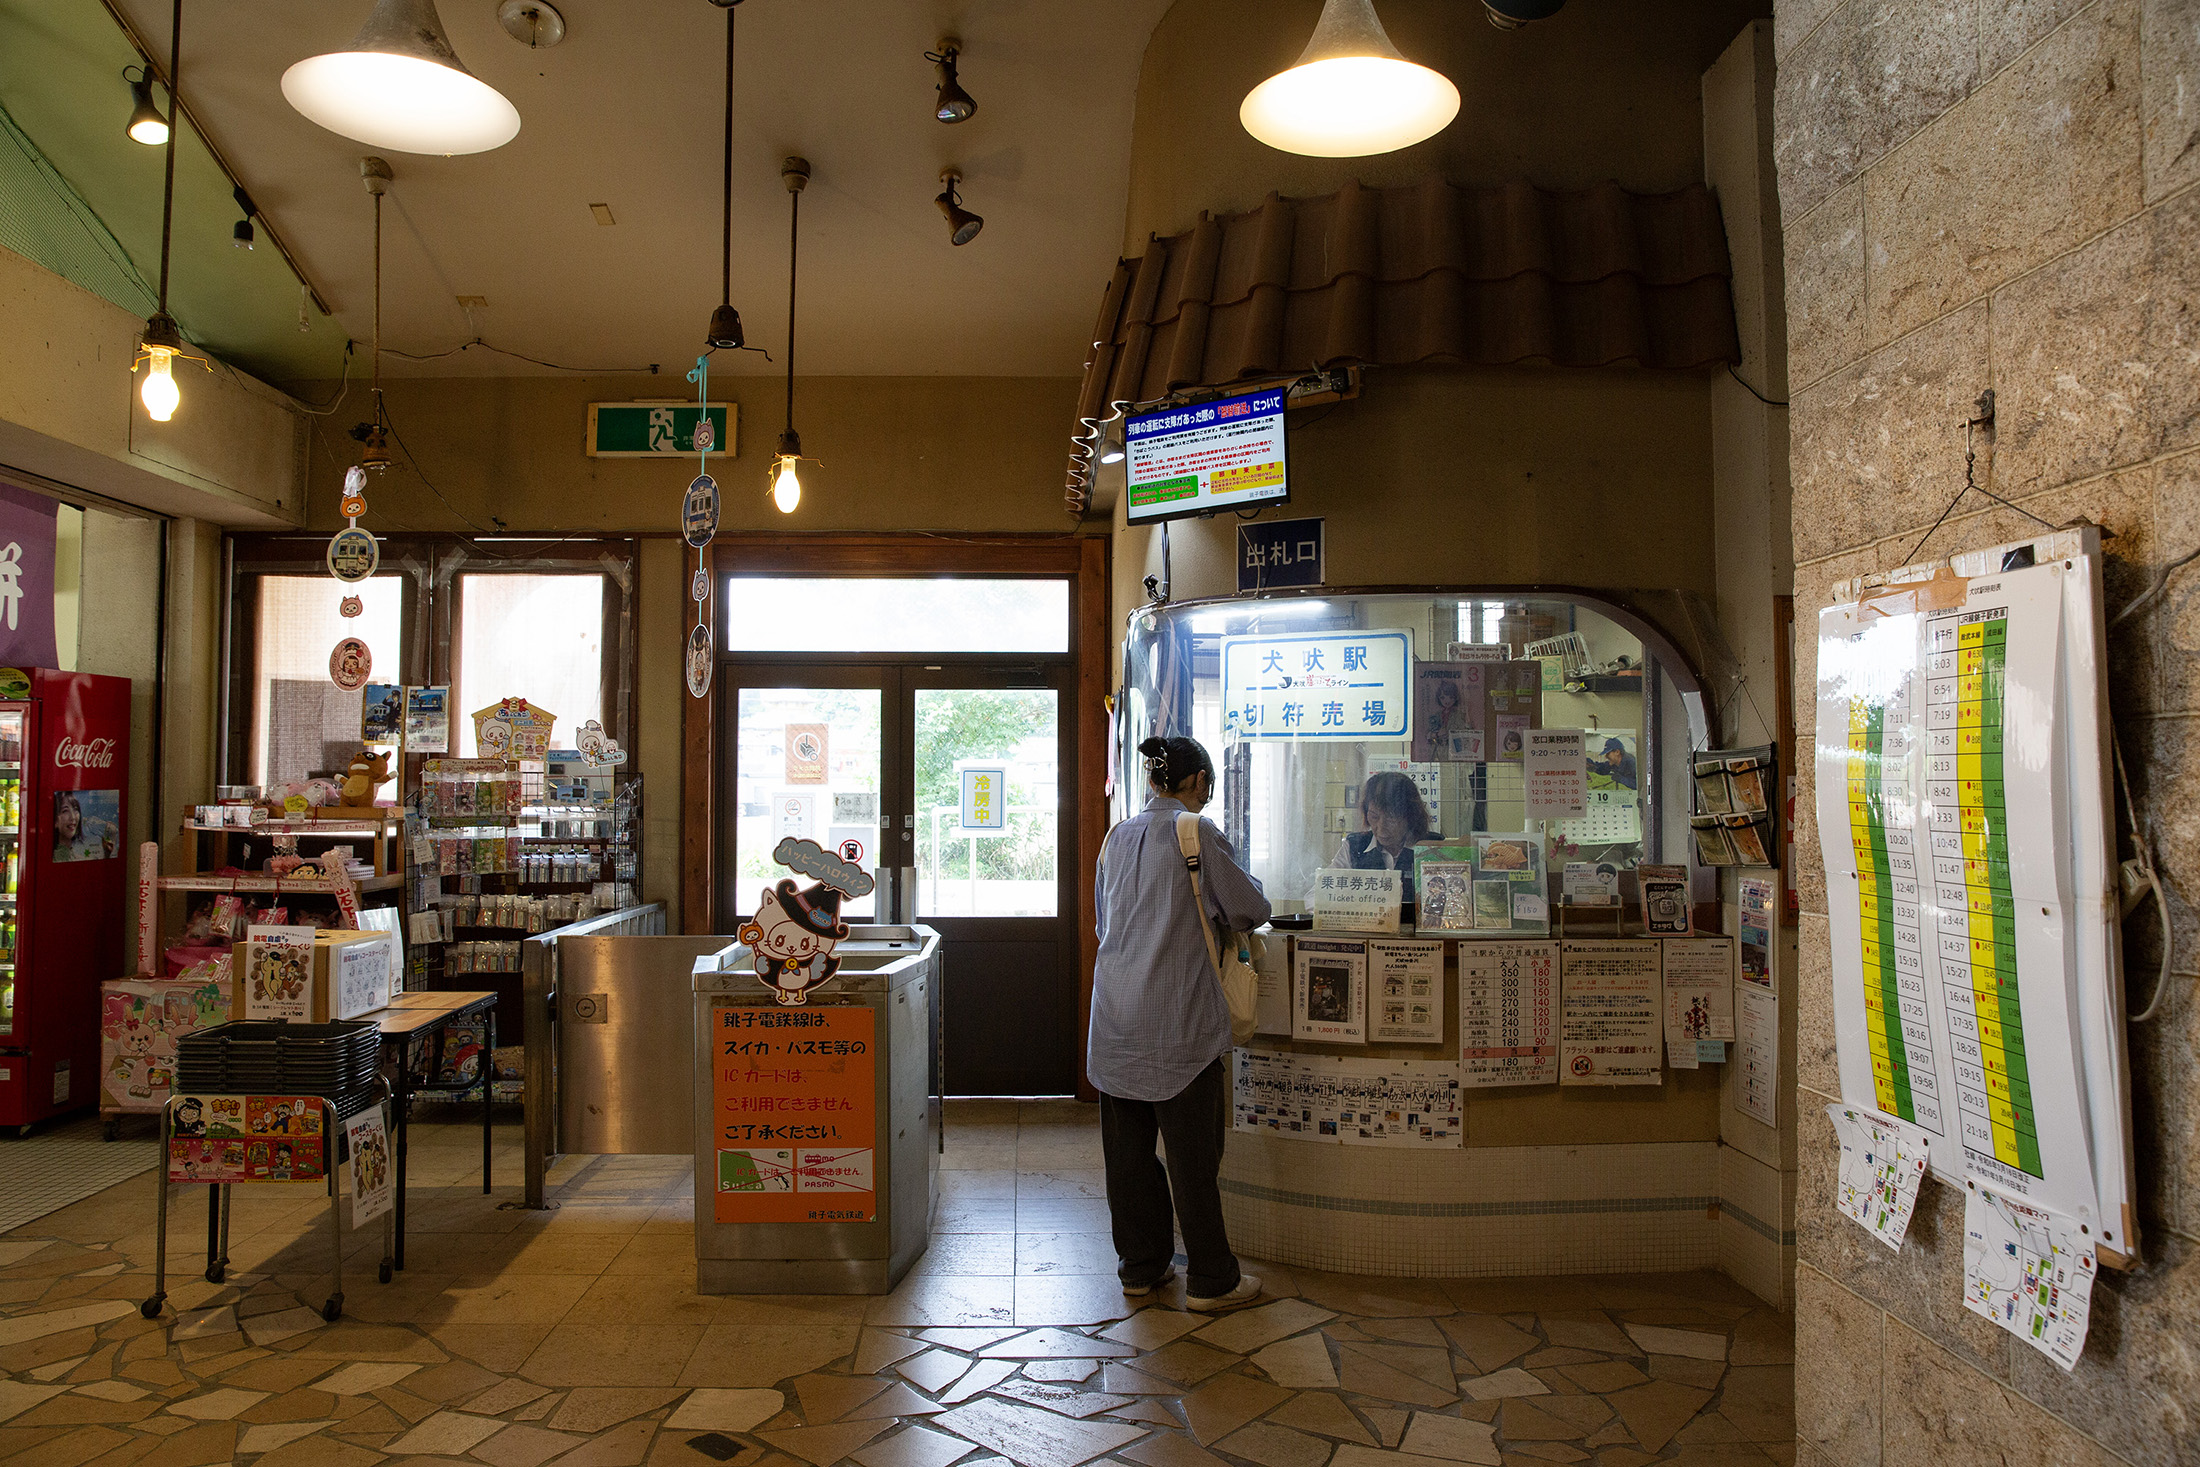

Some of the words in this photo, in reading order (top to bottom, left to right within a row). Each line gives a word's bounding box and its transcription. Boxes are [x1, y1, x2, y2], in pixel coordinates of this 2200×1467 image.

[1246, 540, 1316, 568] 出札口
[1969, 583, 2001, 596] 犬吠駅時刻表
[1262, 646, 1368, 674] 犬吠駅
[1934, 684, 1950, 695] 6:54
[1244, 700, 1386, 727] 切符売場
[1889, 714, 1903, 723] 7:11
[1934, 709, 1950, 720] 7:19
[1532, 736, 1580, 744] 窓口業務時間
[1888, 737, 1902, 747] 7:36
[1934, 735, 1950, 746] 7:45
[1933, 761, 1950, 771] 8:13
[974, 774, 991, 824] 冷房中
[1597, 793, 1608, 801] 10
[1888, 787, 1902, 796] 8:30
[1934, 787, 1950, 797] 8:42
[1973, 796, 1983, 804] 9:43
[1936, 812, 1952, 822] 9:33
[1889, 834, 1908, 845] 10:20
[1936, 838, 1958, 849] 10:42
[782, 845, 867, 890] ハッピーハロウィン
[1893, 858, 1911, 869] 11:35
[1939, 864, 1959, 874] 11:47
[1321, 876, 1393, 892] 乗車券売場
[1328, 894, 1354, 902] Ticket
[1358, 894, 1386, 904] office
[1896, 883, 1914, 894] 12:40
[1942, 890, 1963, 901] 12:48
[1897, 908, 1915, 918] 13:32
[1897, 933, 1916, 944] 14:28
[1944, 941, 1965, 953] 14:37
[1501, 968, 1519, 977] 350
[1533, 968, 1550, 976] 180
[1898, 955, 1918, 967] 15:19
[1946, 966, 1967, 978] 15:27
[1501, 978, 1519, 987] 300
[1533, 978, 1550, 986] 150
[1501, 989, 1519, 997] 300
[1533, 988, 1550, 996] 150
[1901, 979, 1921, 992] 16:23
[1949, 992, 1970, 1004] 16:44
[1501, 998, 1519, 1007] 270
[1533, 998, 1550, 1006] 140
[1501, 1008, 1519, 1017] 240
[1533, 1008, 1550, 1016] 120
[1903, 1004, 1923, 1016] 17:25
[1952, 1016, 1974, 1030] 17:35
[724, 1012, 830, 1028] 銚子電鉄線は、
[1501, 1018, 1519, 1027] 240
[1533, 1017, 1550, 1026] 120
[1501, 1028, 1519, 1037] 210
[1533, 1027, 1550, 1036] 110
[724, 1040, 866, 1056] スイカ・パスモ等の
[1535, 1037, 1546, 1046] 90
[1906, 1028, 1926, 1041] 18:16
[1956, 1043, 1978, 1057] 18:26
[1502, 1058, 1518, 1066] 180
[1534, 1056, 1545, 1065] 90
[1909, 1051, 1929, 1065] 19:07
[1960, 1068, 1981, 1082] 19:15
[724, 1069, 739, 1082] IC
[744, 1069, 808, 1083] カードは、
[1412, 1087, 1429, 1102] 犬吠
[1434, 1087, 1450, 1103] 外川
[1913, 1074, 1933, 1089] 19:58
[1963, 1093, 1984, 1108] 20:13
[725, 1097, 860, 1112] ご利用できません。
[1917, 1104, 1937, 1120] 21:05
[1966, 1124, 1989, 1140] 21:18
[725, 1125, 842, 1140] ご了承ください。
[722, 1181, 762, 1190] Suica
[808, 1211, 864, 1220] 銚子電気鉄道
